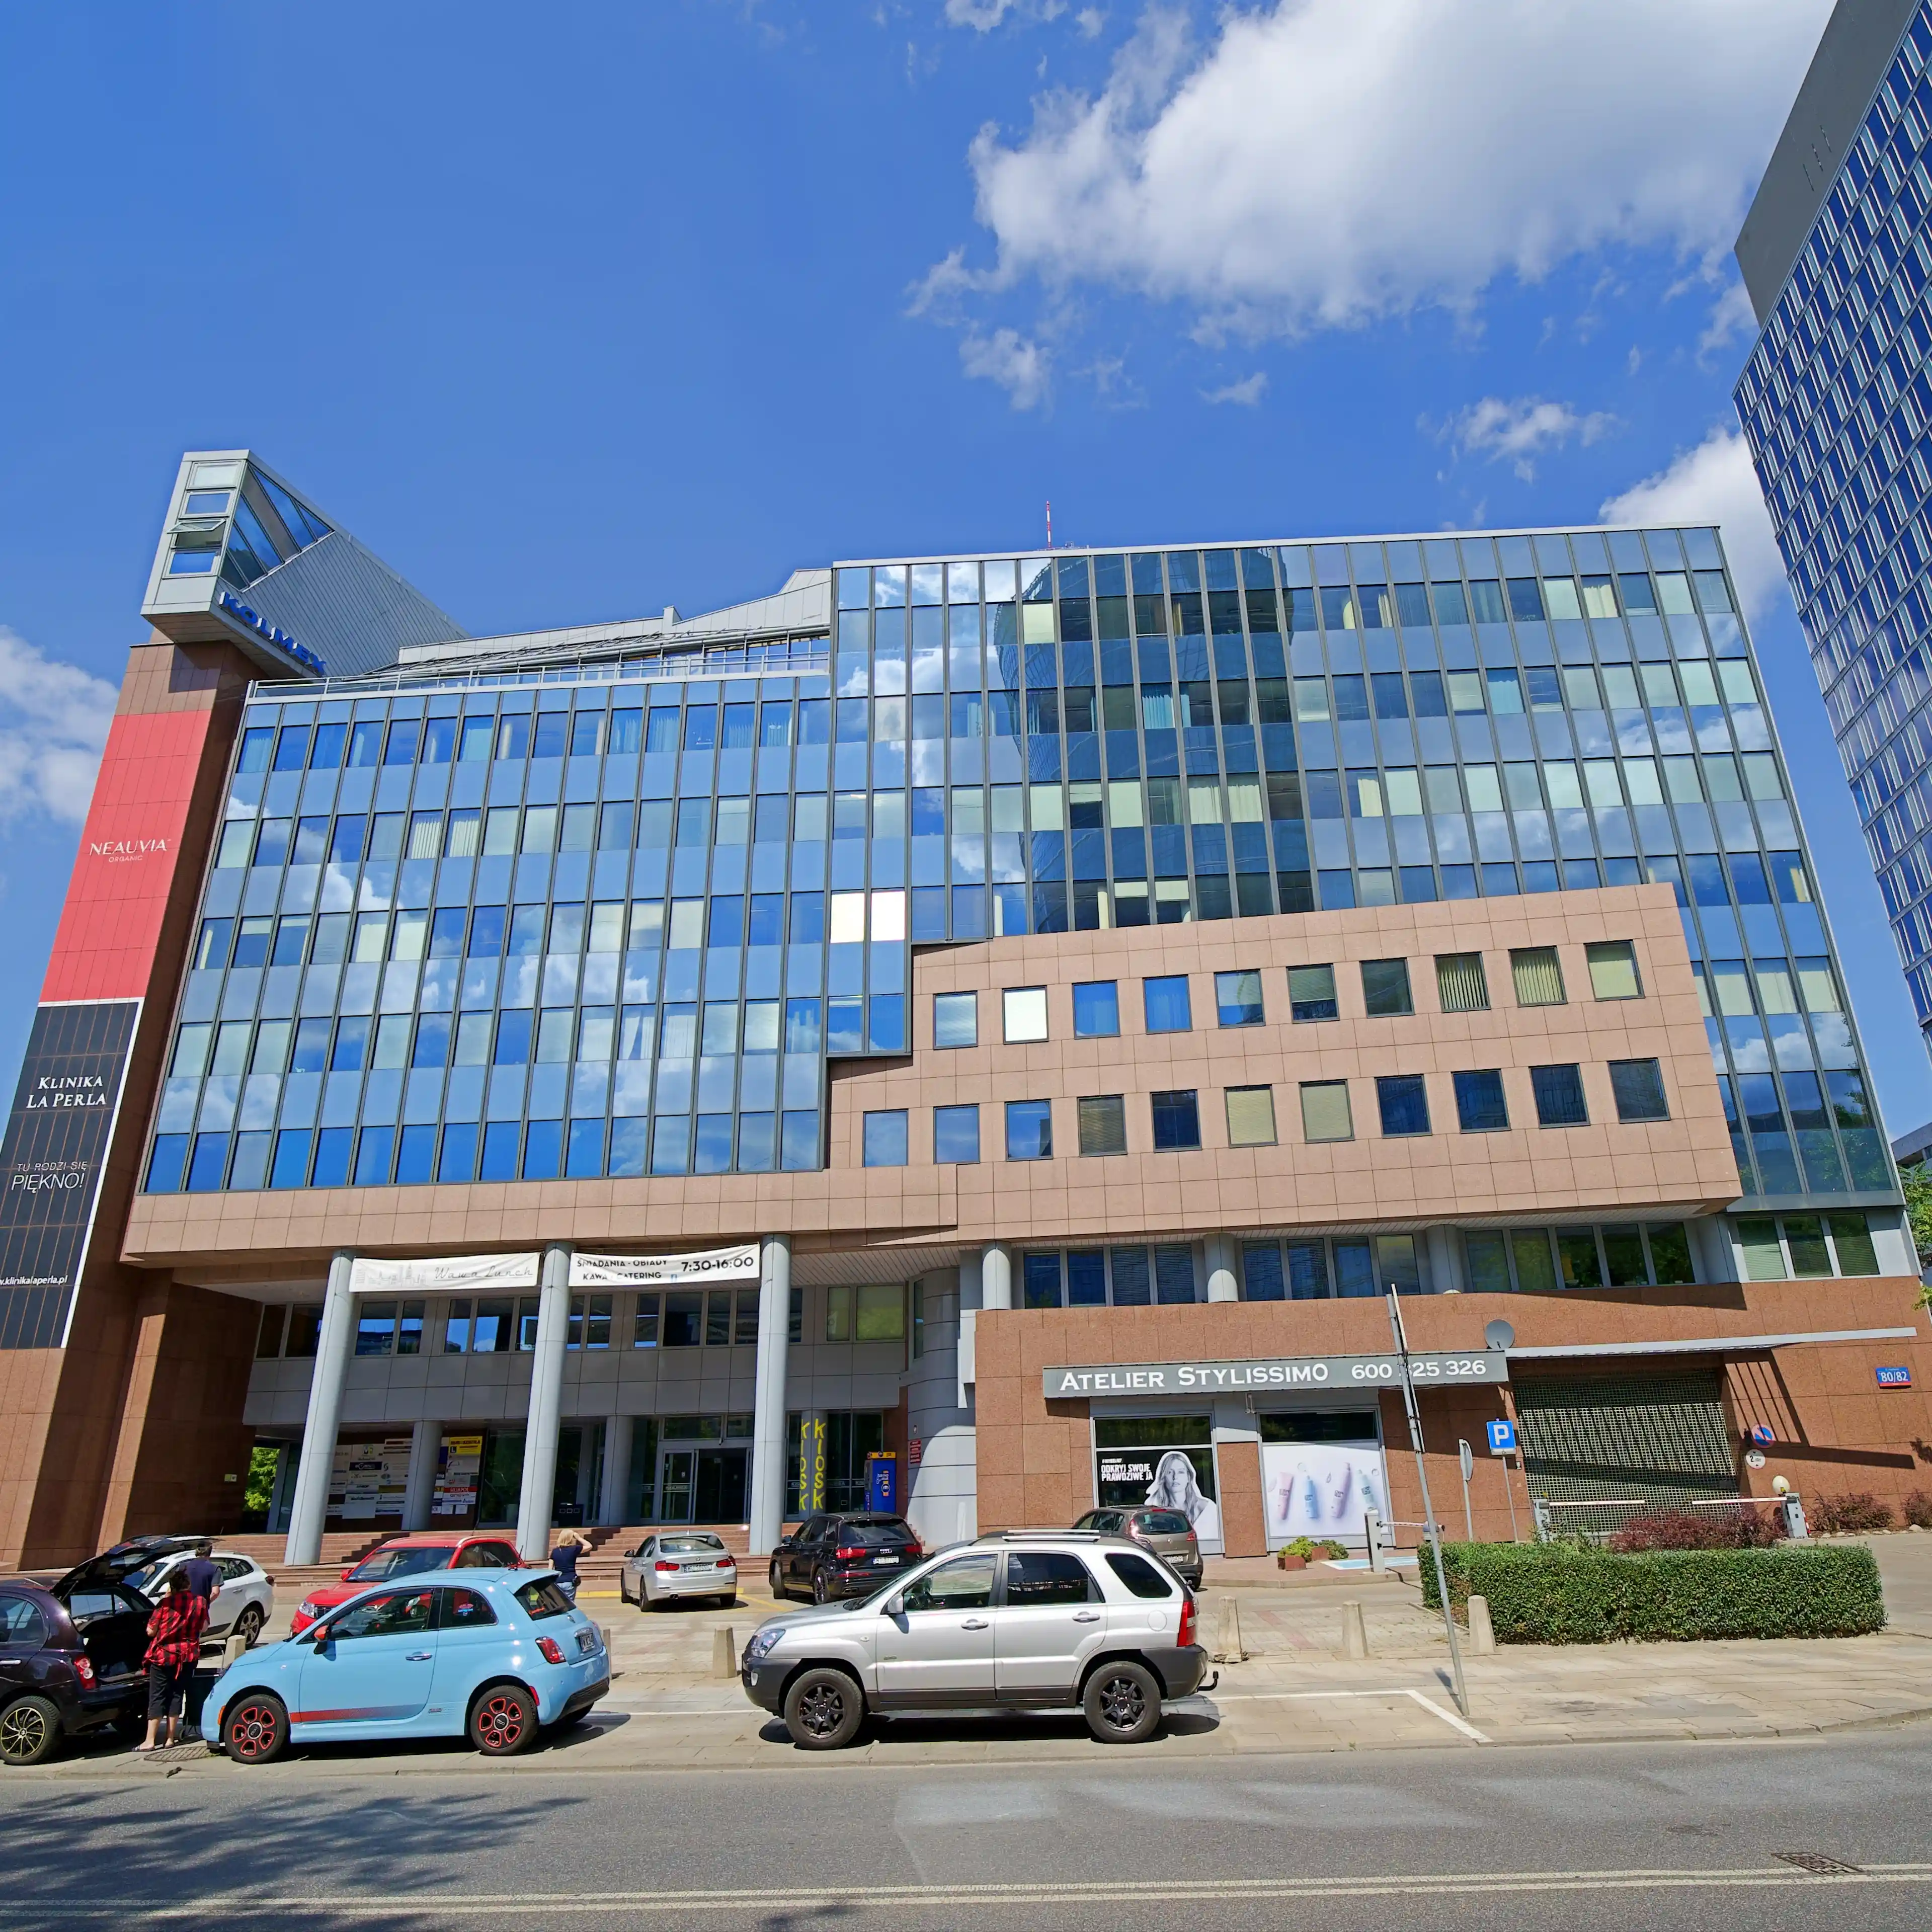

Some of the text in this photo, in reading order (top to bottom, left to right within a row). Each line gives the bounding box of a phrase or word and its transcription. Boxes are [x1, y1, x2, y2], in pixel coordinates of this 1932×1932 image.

[218, 591, 326, 676] KOLMEX
[90, 839, 167, 856] NEAUVIA
[38, 1076, 103, 1089] KLINIKA
[26, 1093, 107, 1108] LA PERLA
[17, 1161, 88, 1171] TU RODZI SIĘ
[11, 1172, 85, 1193] PIĘKNO!
[435, 1265, 533, 1279] Wawa Lunch
[681, 1257, 754, 1272] 7:30-16:00
[1060, 1360, 1486, 1391] ATELIER STYLISSIMO 600 25 326
[1881, 1371, 1908, 1383] 80/82
[1493, 1424, 1509, 1445] P
[813, 1418, 826, 1510] KIOSK
[1101, 1464, 1151, 1473] ODKRYJ SWOJE
[1101, 1471, 1153, 1482] PRAWDZIWE JA
